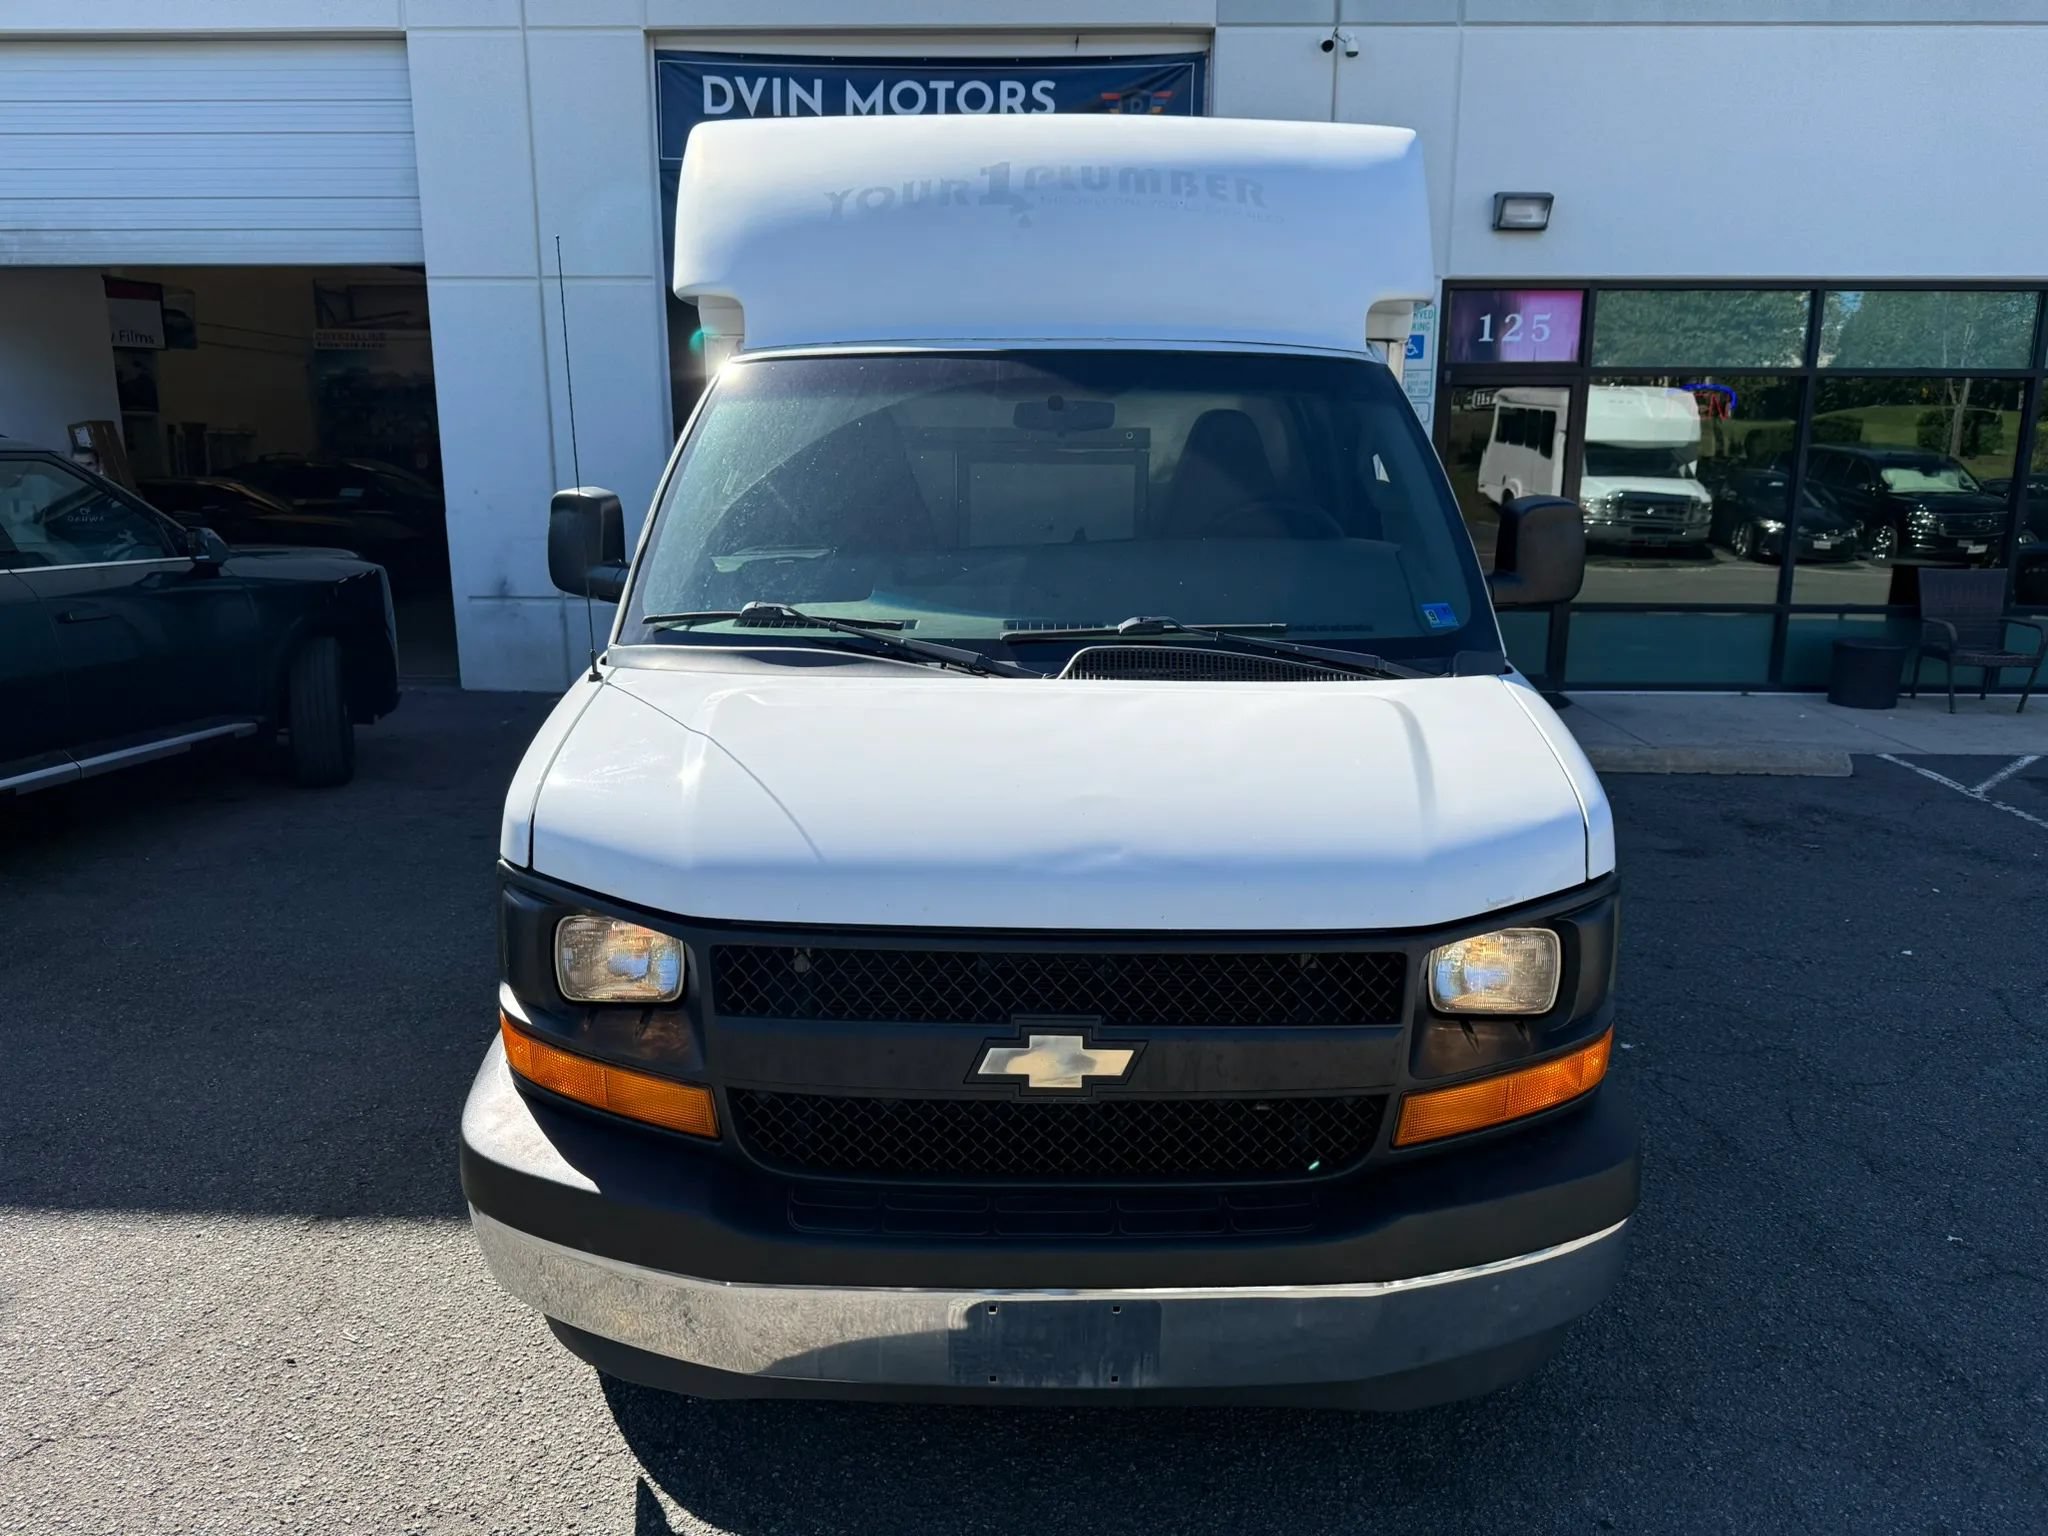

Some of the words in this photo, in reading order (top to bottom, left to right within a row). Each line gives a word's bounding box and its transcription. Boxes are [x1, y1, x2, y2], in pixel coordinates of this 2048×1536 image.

[702, 75, 824, 117] DVIN
[846, 79, 1057, 116] MOTORS
[823, 176, 971, 222] YOUR
[119, 328, 155, 345] Films
[1477, 312, 1553, 344] 125
